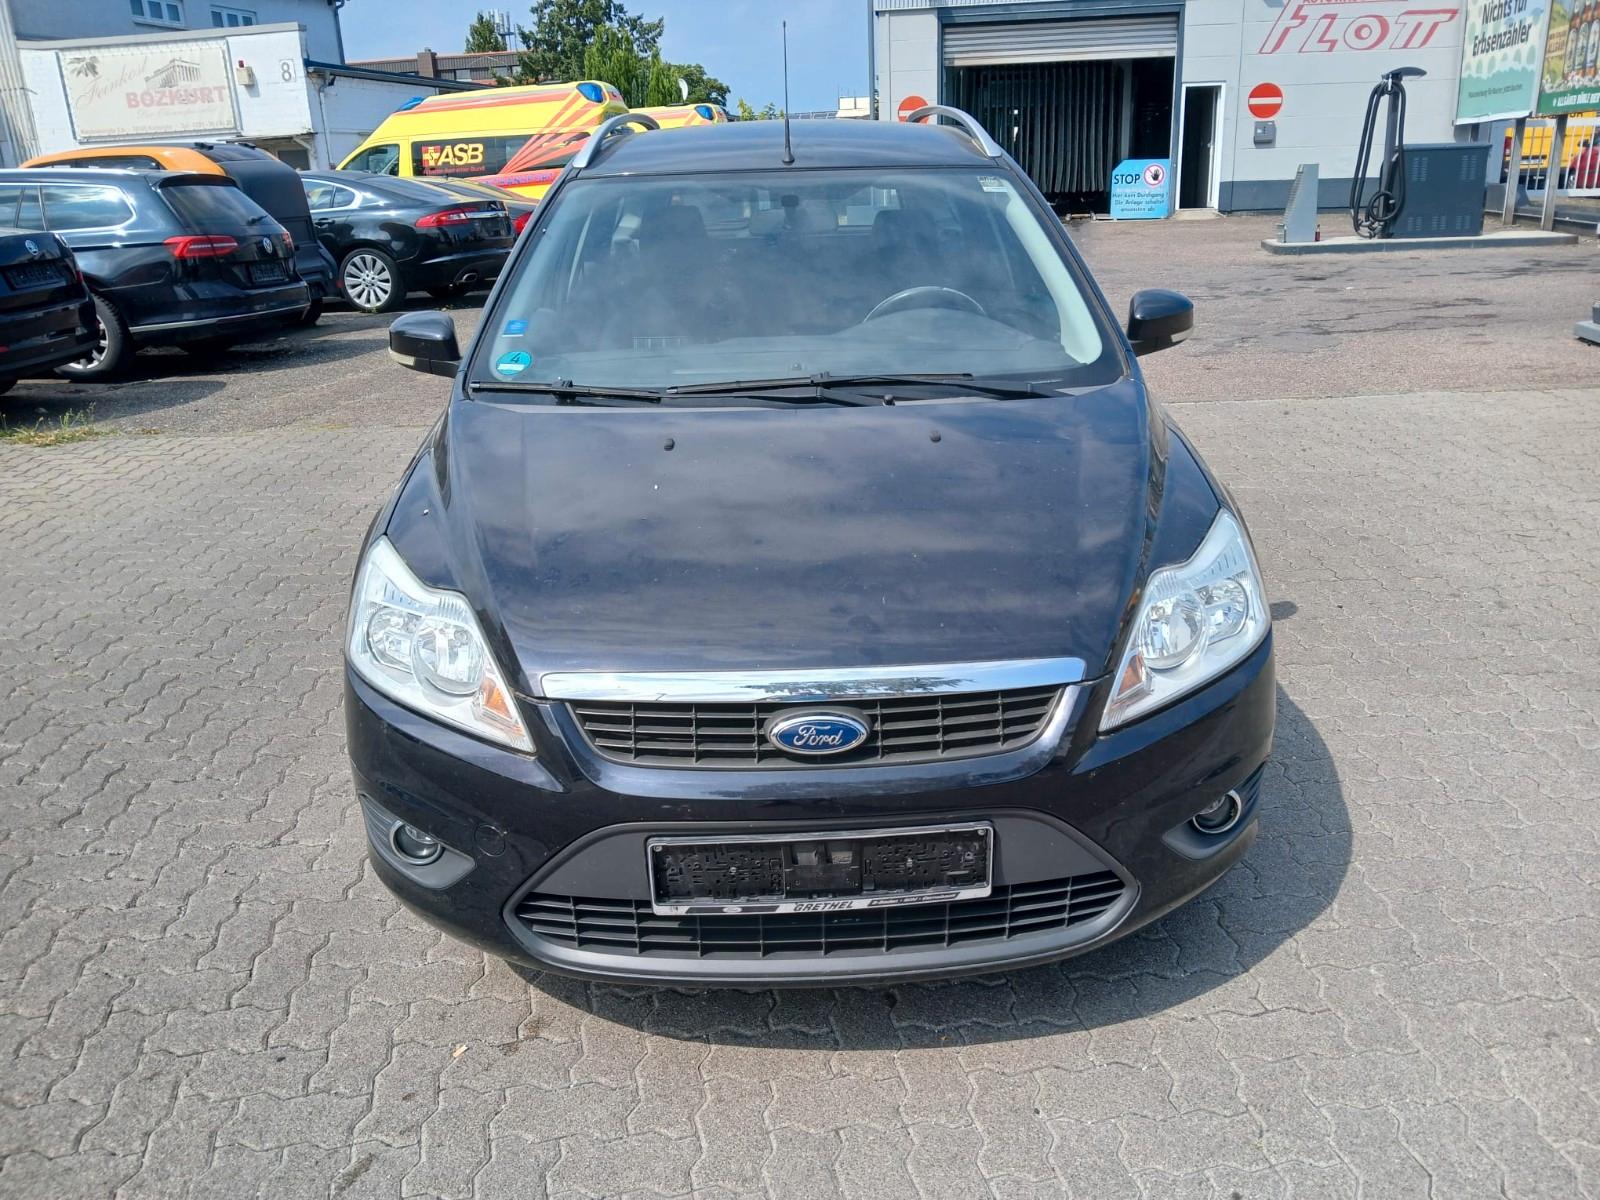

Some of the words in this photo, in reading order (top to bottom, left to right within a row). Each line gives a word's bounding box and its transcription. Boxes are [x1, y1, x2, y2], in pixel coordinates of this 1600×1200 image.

[1482, 0, 1512, 25] Nichts
[1472, 20, 1532, 57] Erbsenzähler
[281, 62, 292, 81] 8
[125, 86, 226, 109] BOZKURT
[438, 143, 484, 166] ASB
[1114, 174, 1140, 185] STOP
[511, 352, 521, 363] 4
[793, 724, 843, 747] Ford
[794, 900, 854, 912] GRETHEL
